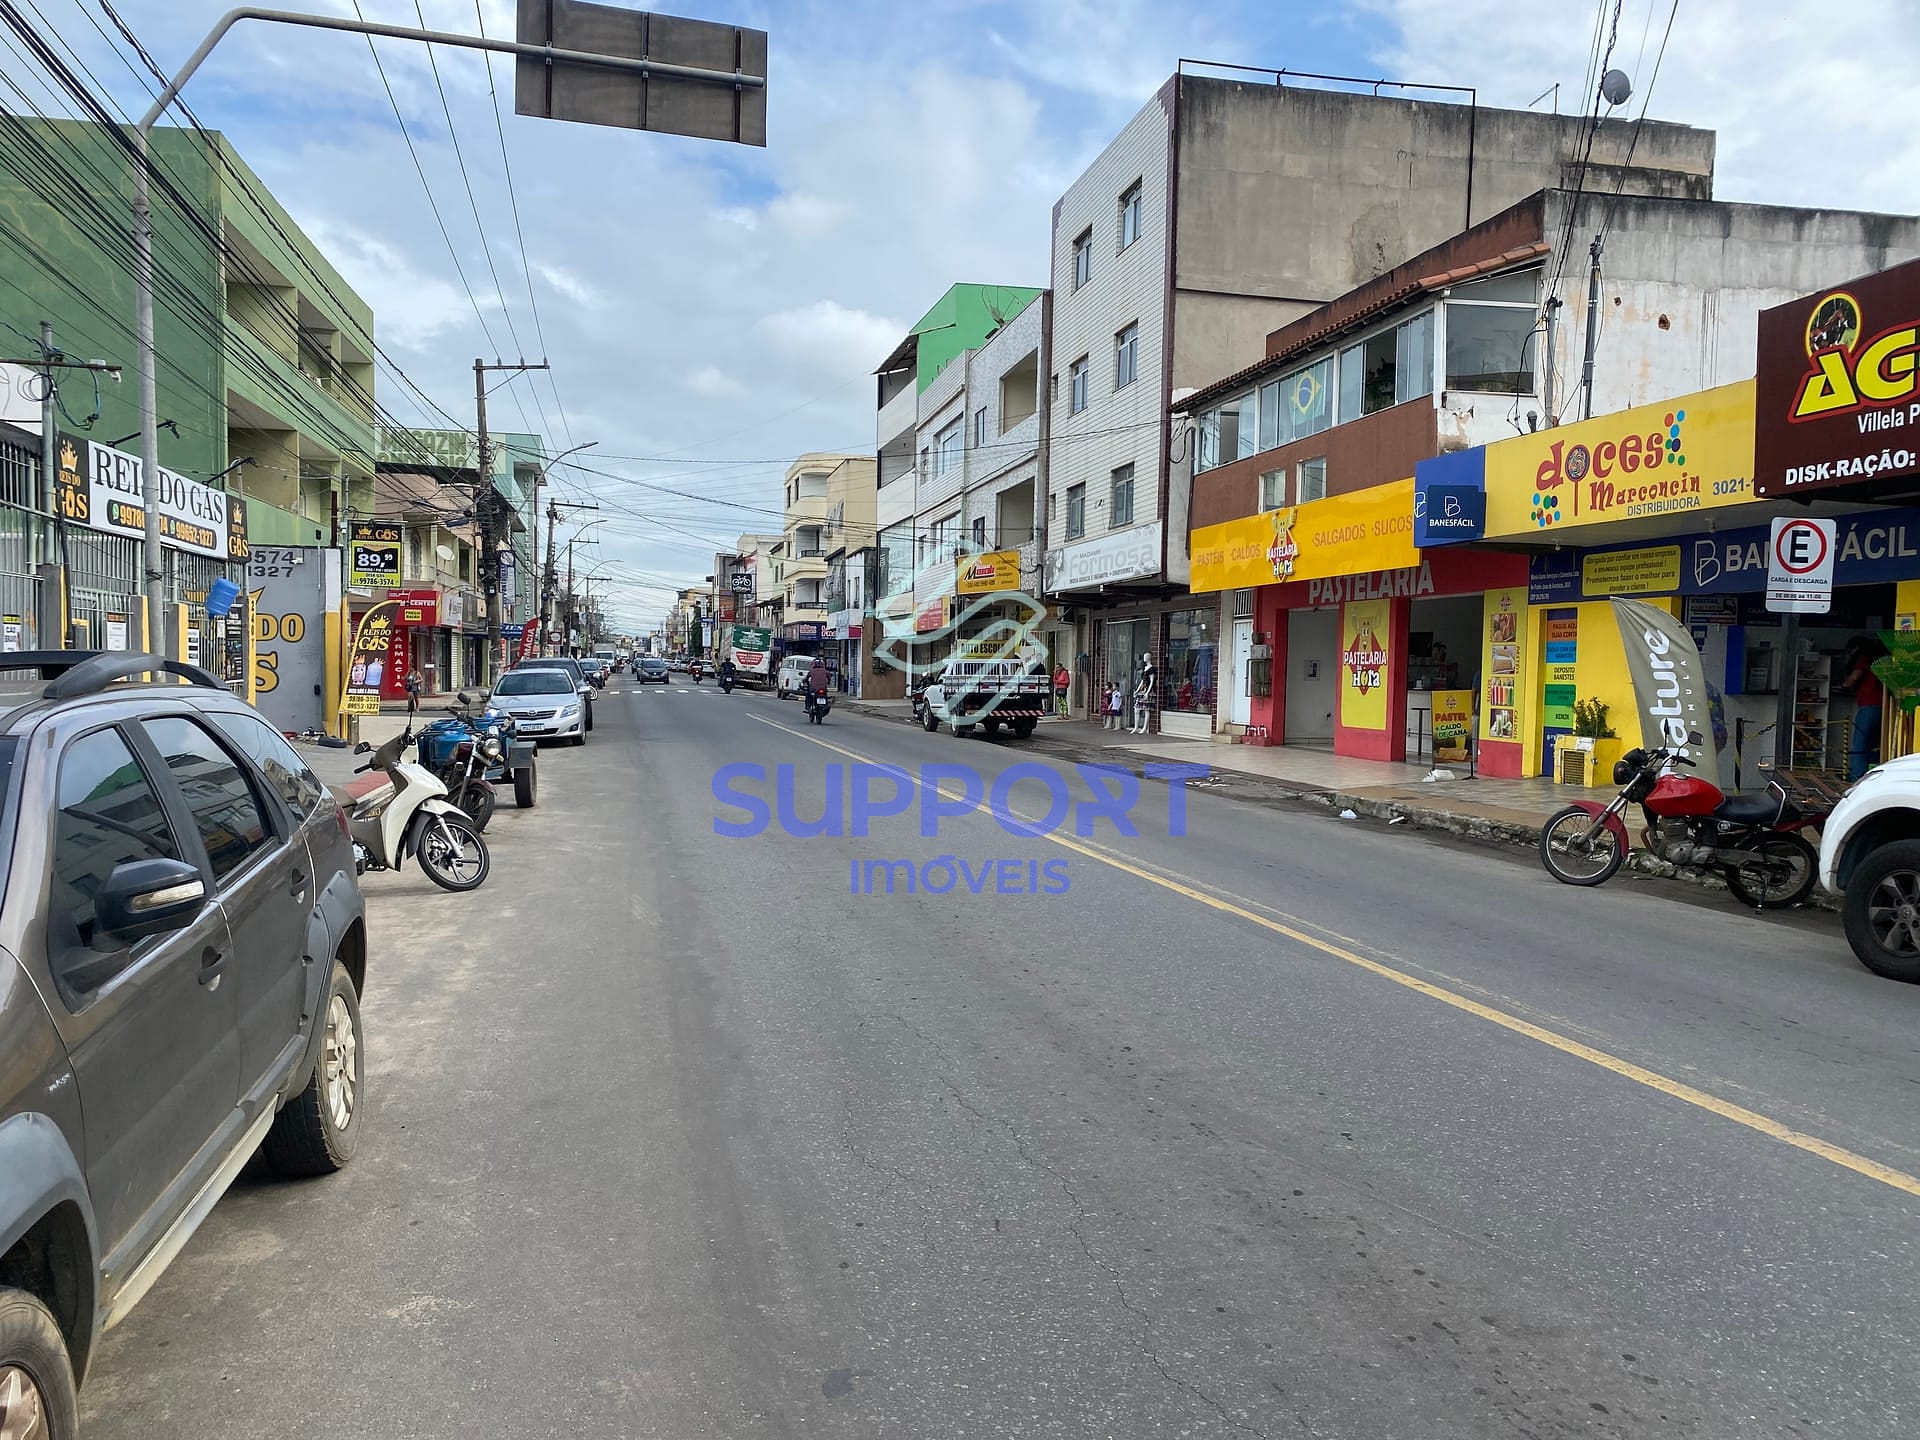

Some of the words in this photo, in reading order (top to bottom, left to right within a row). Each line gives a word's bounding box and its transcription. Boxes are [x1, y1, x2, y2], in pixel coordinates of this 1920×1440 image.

[1857, 408, 1905, 433] Villela
[1535, 432, 1664, 491] doces
[1785, 448, 1916, 486] DISK-RAÇÃO:
[1589, 472, 1701, 511] Marconcin
[1627, 496, 1701, 516] DISTRIBUIDORA
[1313, 523, 1366, 547] SALGADOS
[1374, 515, 1413, 536] SUCOS
[1429, 518, 1475, 527] BANESFÁCIL
[1231, 544, 1261, 561] CALDOS
[1266, 541, 1298, 560] PASTELARIA
[1789, 529, 1811, 563] E
[1309, 559, 1435, 605] PASTELARIA
[1620, 574, 1634, 582] fazer
[1639, 572, 1661, 580] melhor
[1661, 571, 1676, 580] para
[1794, 577, 1828, 585] DESCARGA
[410, 599, 436, 607] CENTER
[961, 643, 979, 654] AUTO
[1344, 650, 1387, 665] PASTELARIA
[1435, 712, 1468, 721] PASTEL
[1440, 722, 1462, 730] CALDO
[1448, 728, 1468, 737] CANA
